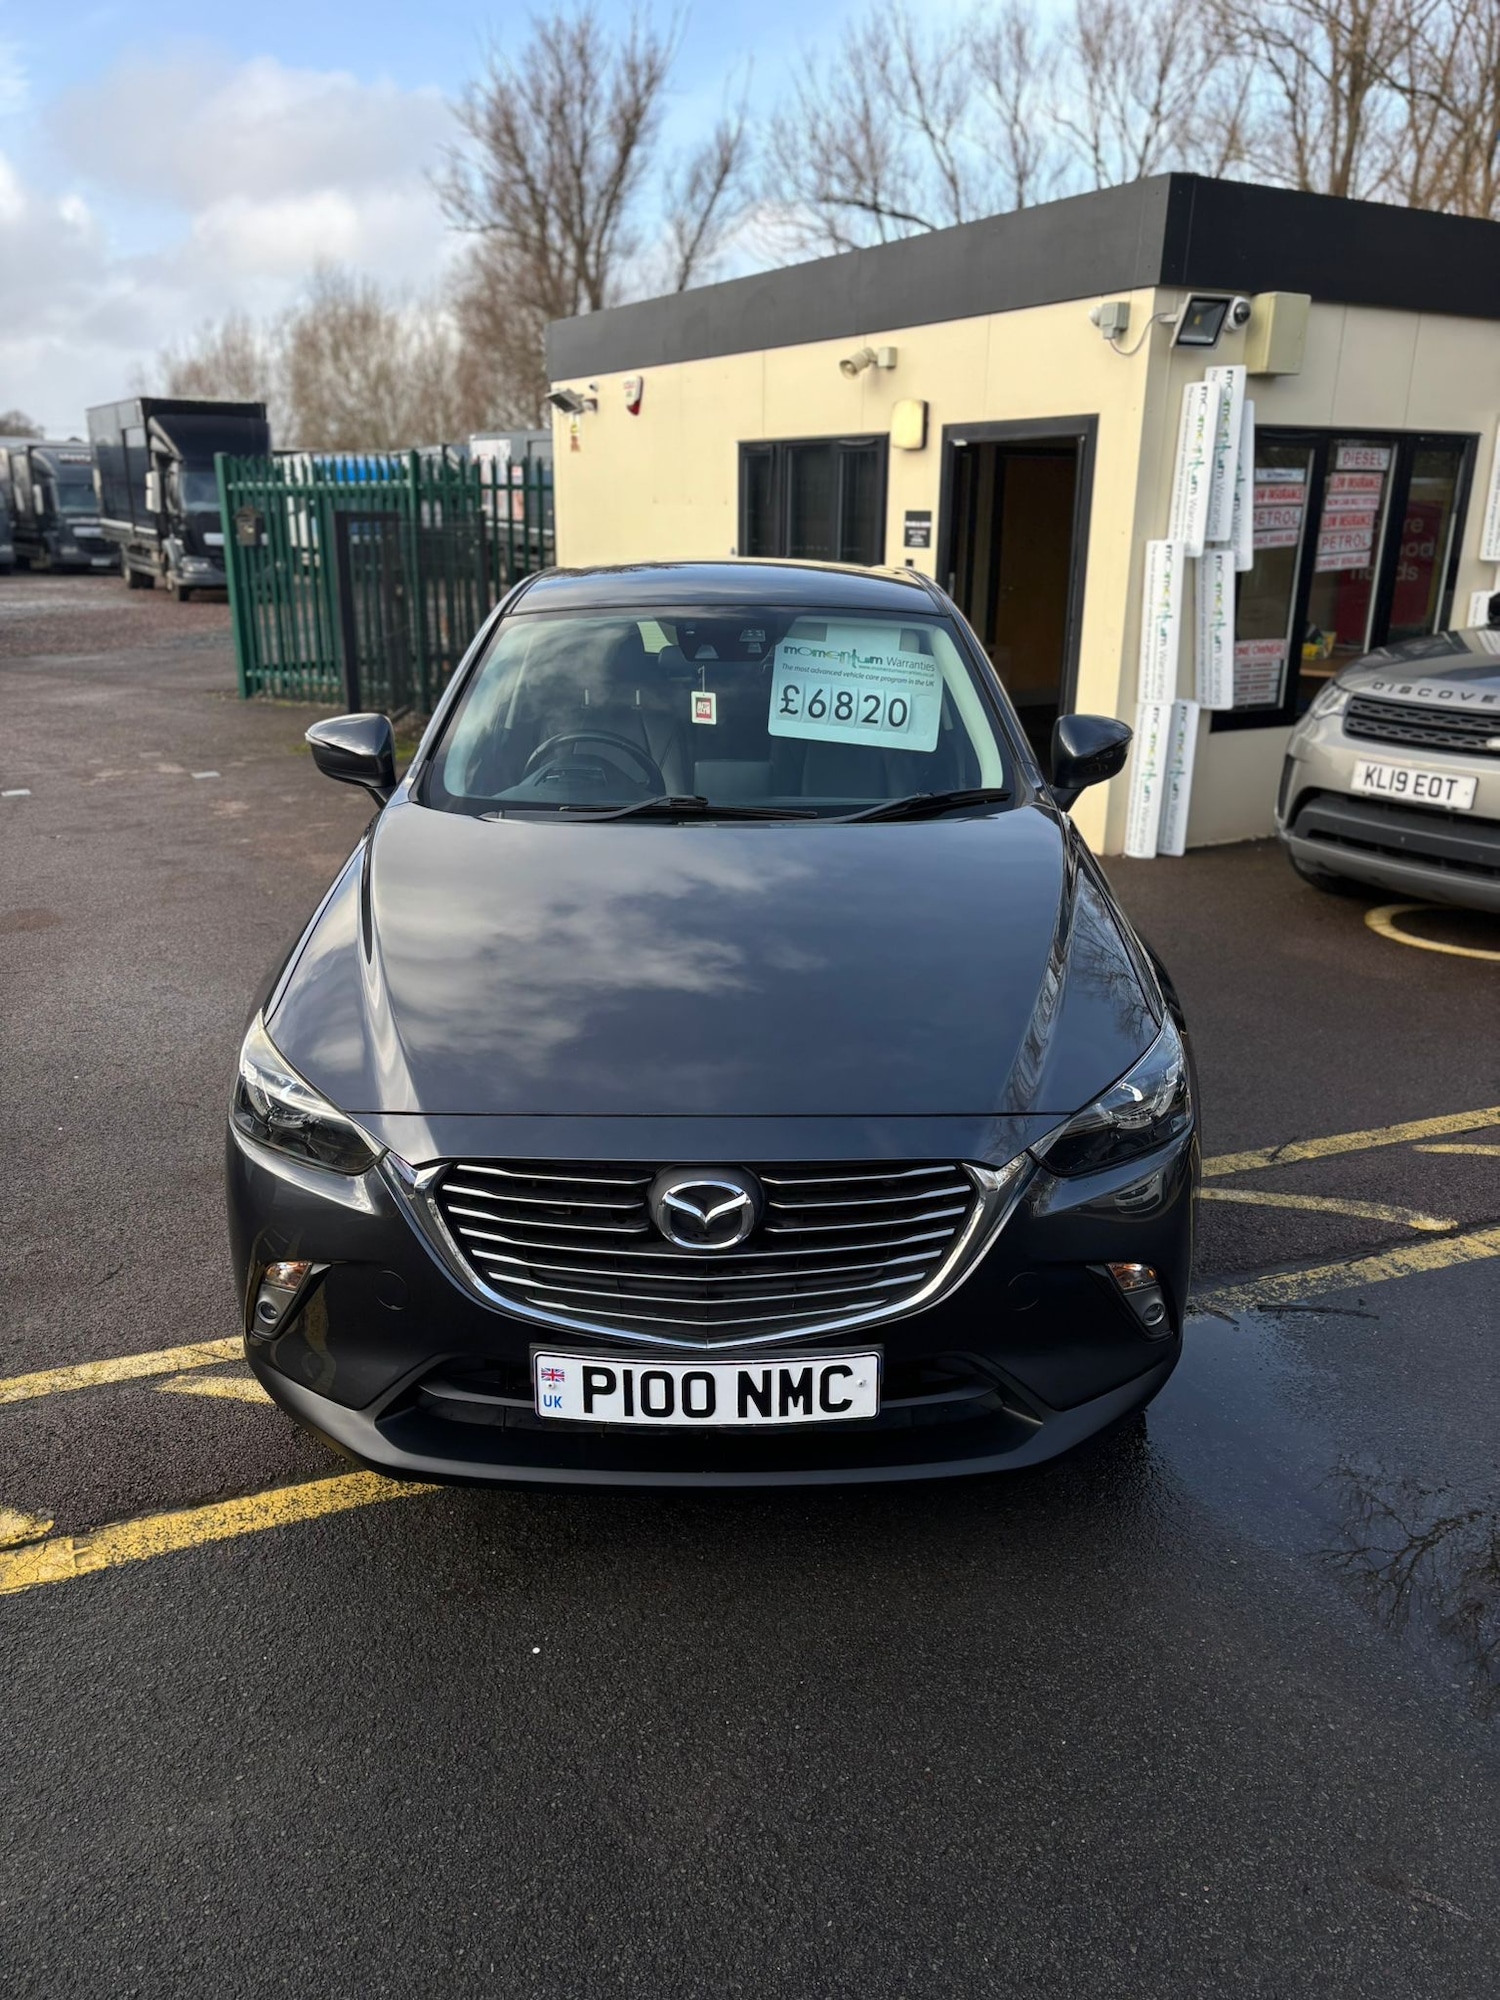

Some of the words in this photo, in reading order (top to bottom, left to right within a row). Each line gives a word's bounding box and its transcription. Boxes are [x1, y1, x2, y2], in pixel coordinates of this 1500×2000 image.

[1188, 386, 1208, 495] momentum
[1343, 451, 1383, 466] DIESEL
[1322, 533, 1367, 549] PETROL
[1156, 544, 1173, 647] momentum
[1210, 555, 1227, 654] momentum
[784, 646, 883, 668] momentum
[886, 656, 935, 672] Warranties
[810, 668, 842, 676] advanced
[843, 671, 864, 679] vehicle
[880, 676, 907, 684] program
[1372, 680, 1498, 703] DISCOVE
[779, 684, 908, 728] £6820
[1363, 765, 1408, 792] KL19
[1413, 775, 1459, 801] EOT
[543, 1394, 563, 1409] UK
[582, 1364, 716, 1419] P100
[737, 1364, 853, 1418] NMC
